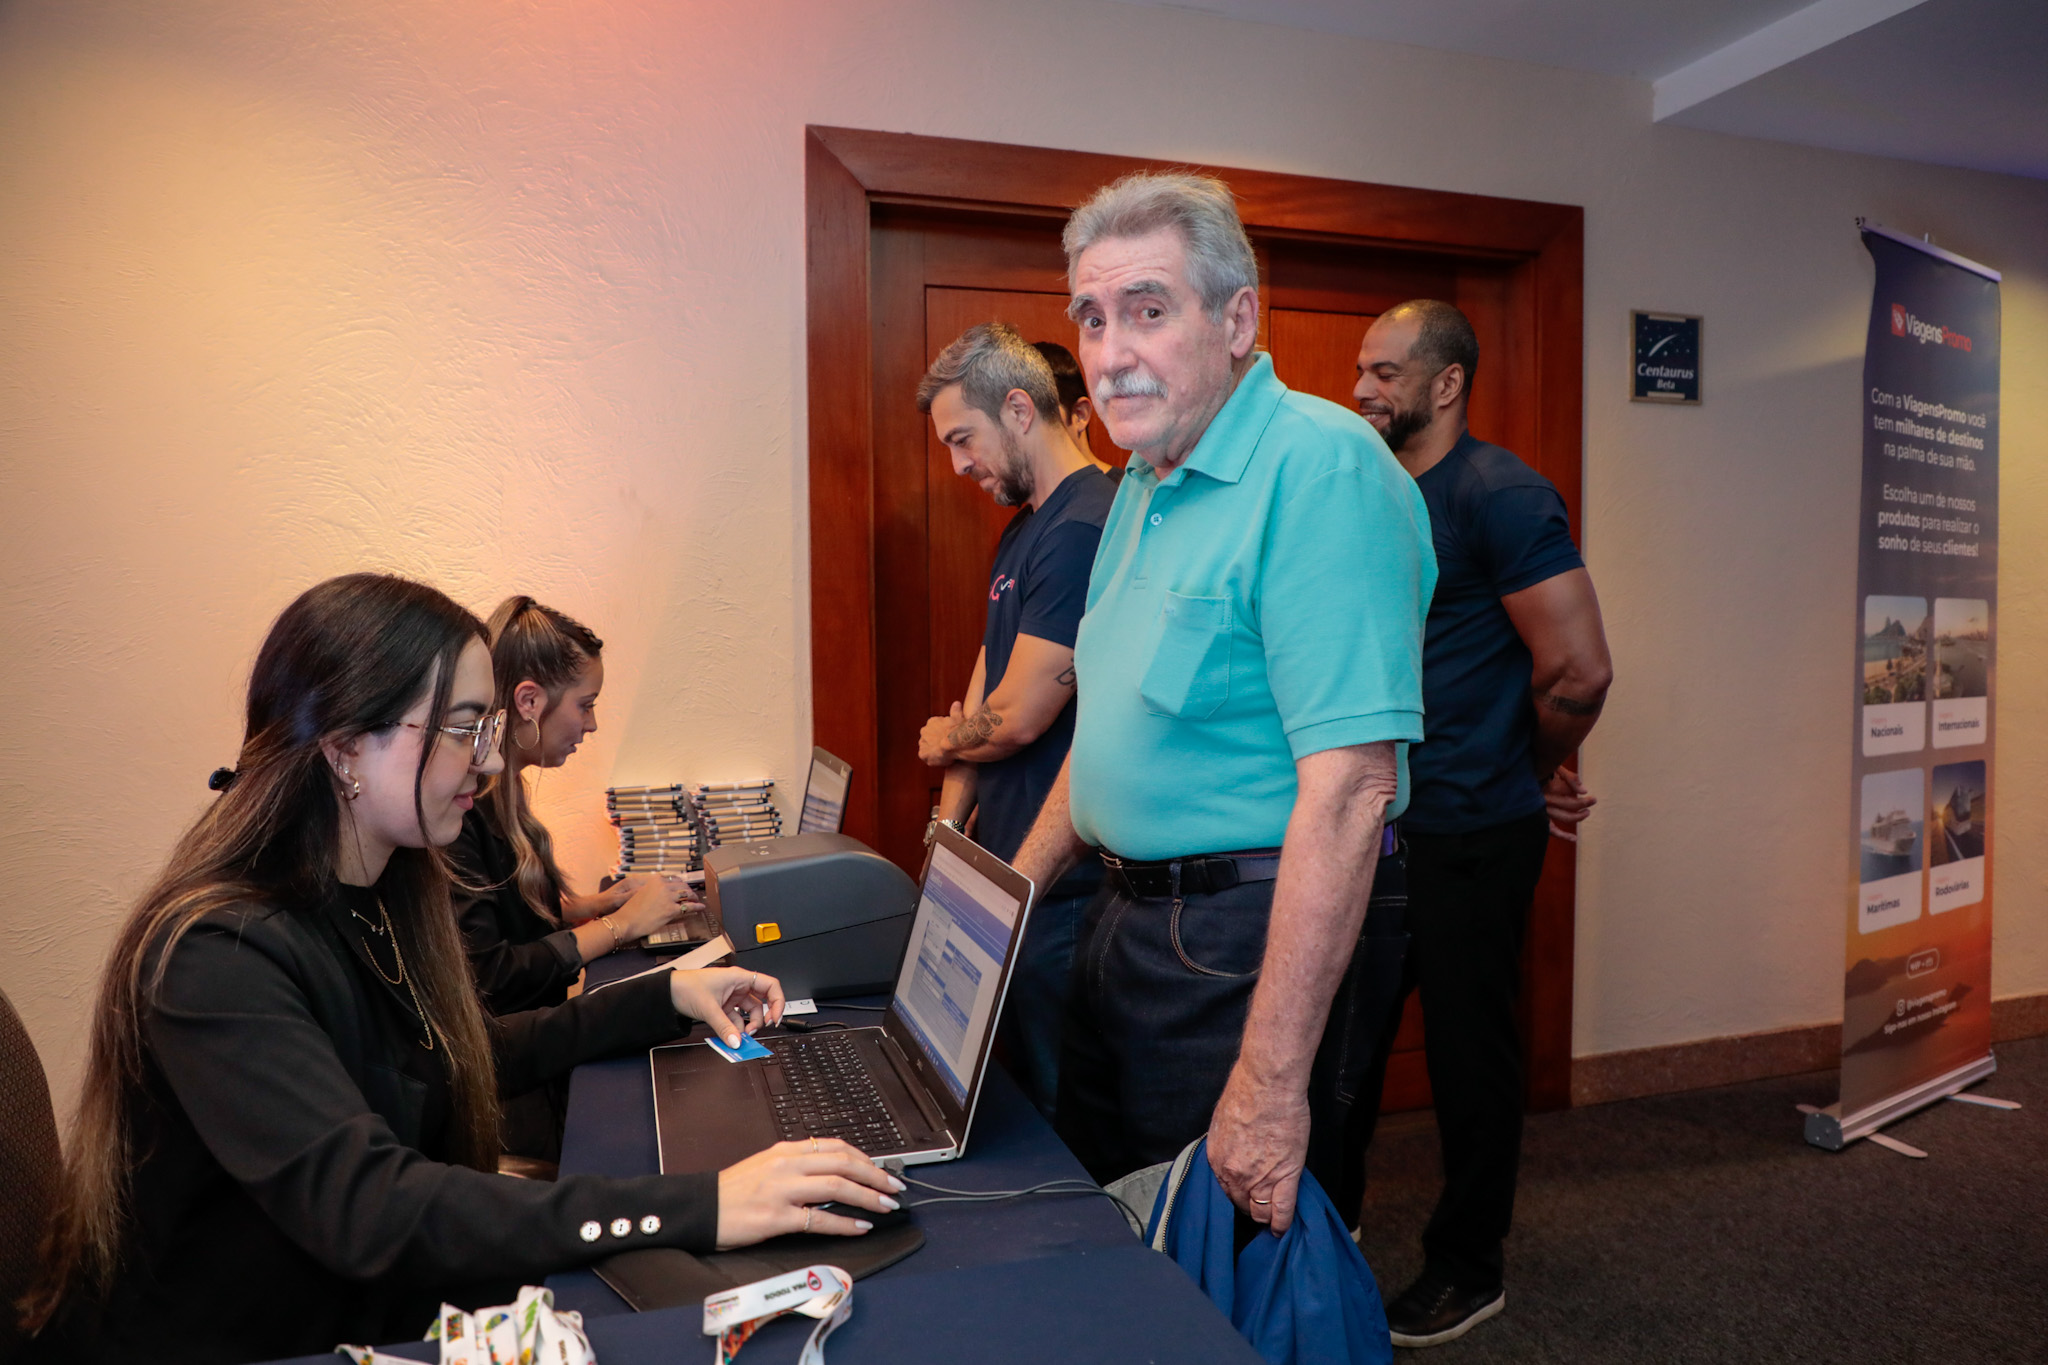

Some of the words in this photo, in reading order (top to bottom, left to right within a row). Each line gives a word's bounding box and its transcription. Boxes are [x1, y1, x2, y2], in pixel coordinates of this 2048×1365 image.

[1905, 313, 1972, 352] ViagensPromo
[1637, 363, 1694, 379] Centaurus
[1656, 379, 1676, 390] Beta
[1871, 388, 1894, 406] Com
[1896, 396, 1902, 408] a
[1903, 395, 1967, 424] ViagensPromo
[1967, 413, 1986, 428] você
[1874, 414, 1894, 431] tem
[1896, 418, 1935, 440] milhares
[1936, 426, 1947, 443] de
[1948, 429, 1984, 450] destinos
[1884, 443, 1896, 457] na
[1898, 444, 1925, 461] palma
[1927, 448, 1938, 464] de
[1940, 453, 1954, 468] sua
[1956, 455, 1976, 471] mão.
[1884, 484, 1918, 504] Escolha
[1919, 493, 1935, 506] um
[1936, 491, 1946, 507] de
[1948, 497, 1976, 512] nossos
[1878, 510, 1920, 528] produtos
[1922, 515, 1941, 532] para
[1942, 517, 1972, 535] realizar
[1973, 523, 1980, 535] o
[1878, 534, 1908, 551] sonho
[1910, 536, 1921, 552] de
[1922, 540, 1942, 554] seus
[1943, 539, 1979, 557] clientes!
[1871, 724, 1904, 738] Nacionais
[1938, 718, 1980, 732] Internacionais
